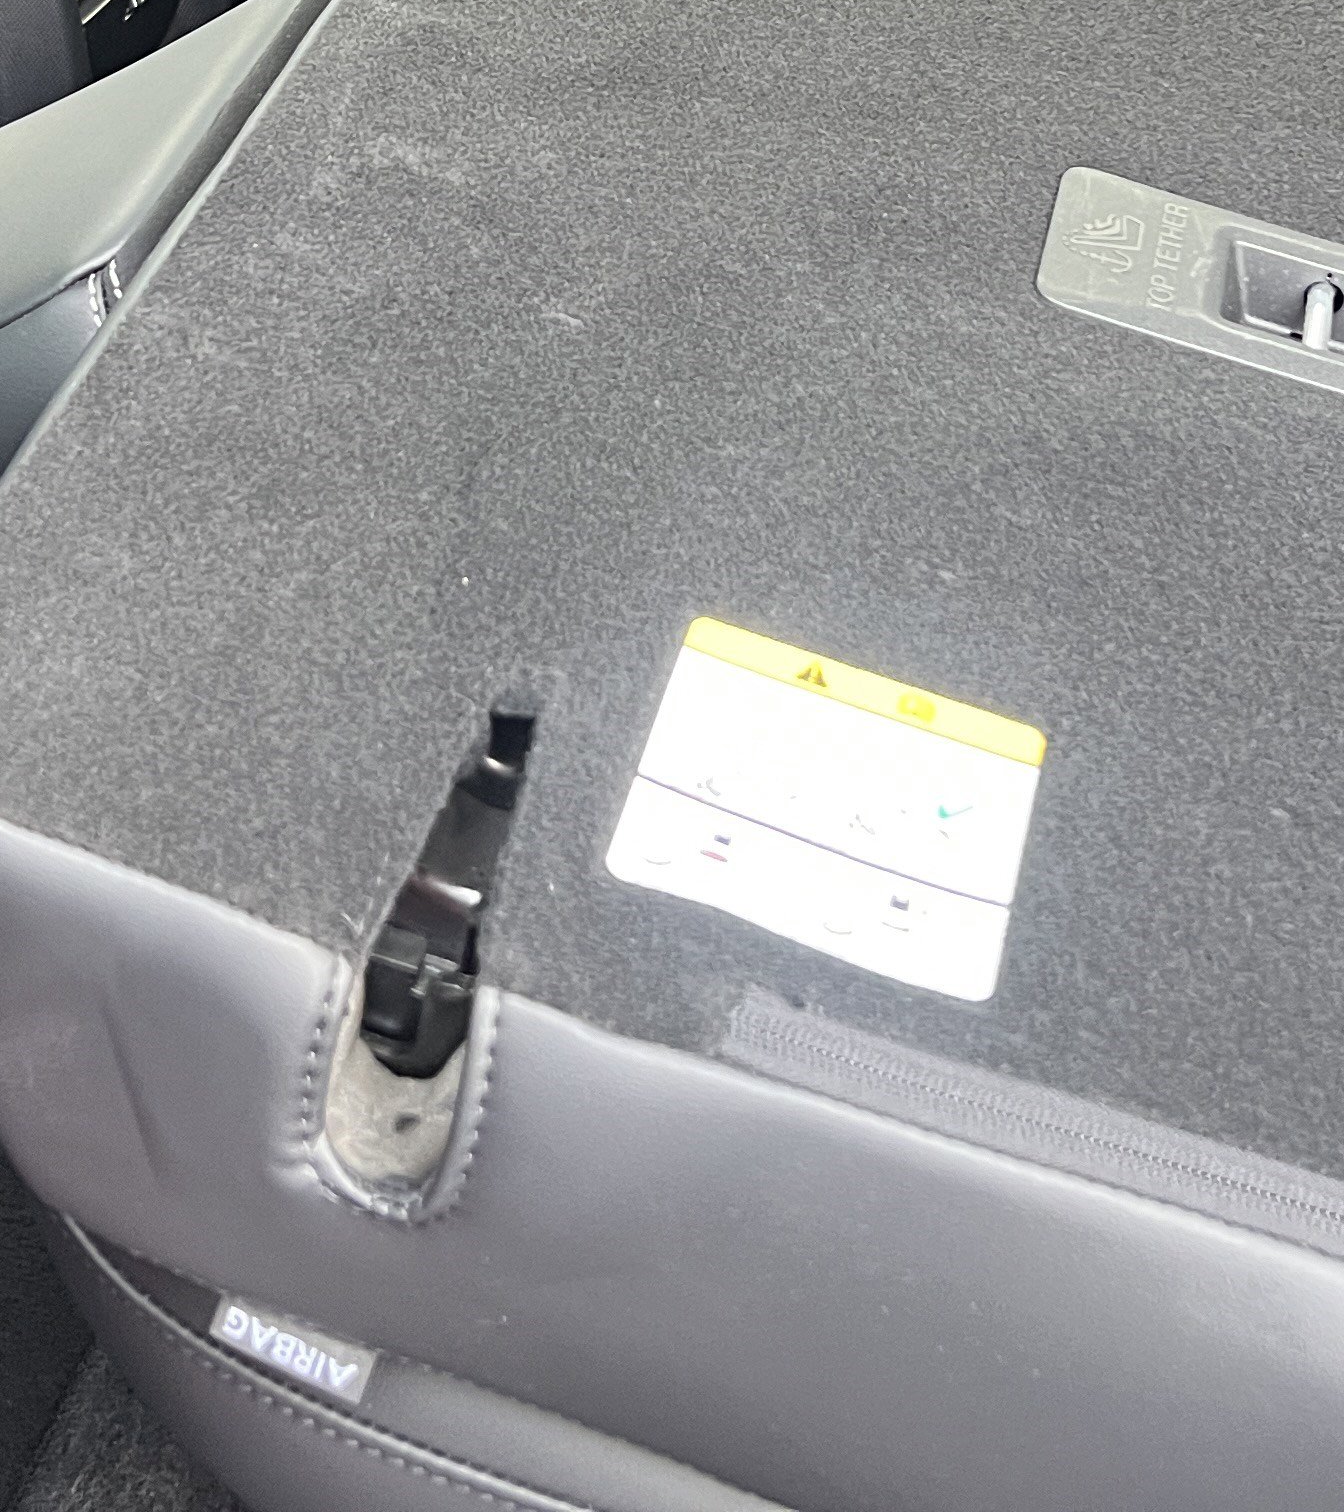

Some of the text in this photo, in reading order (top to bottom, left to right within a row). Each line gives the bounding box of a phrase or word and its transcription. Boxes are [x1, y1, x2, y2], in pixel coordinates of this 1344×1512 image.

[1146, 202, 1190, 309] TOP TETHER
[222, 1306, 358, 1387] AIRBAG
